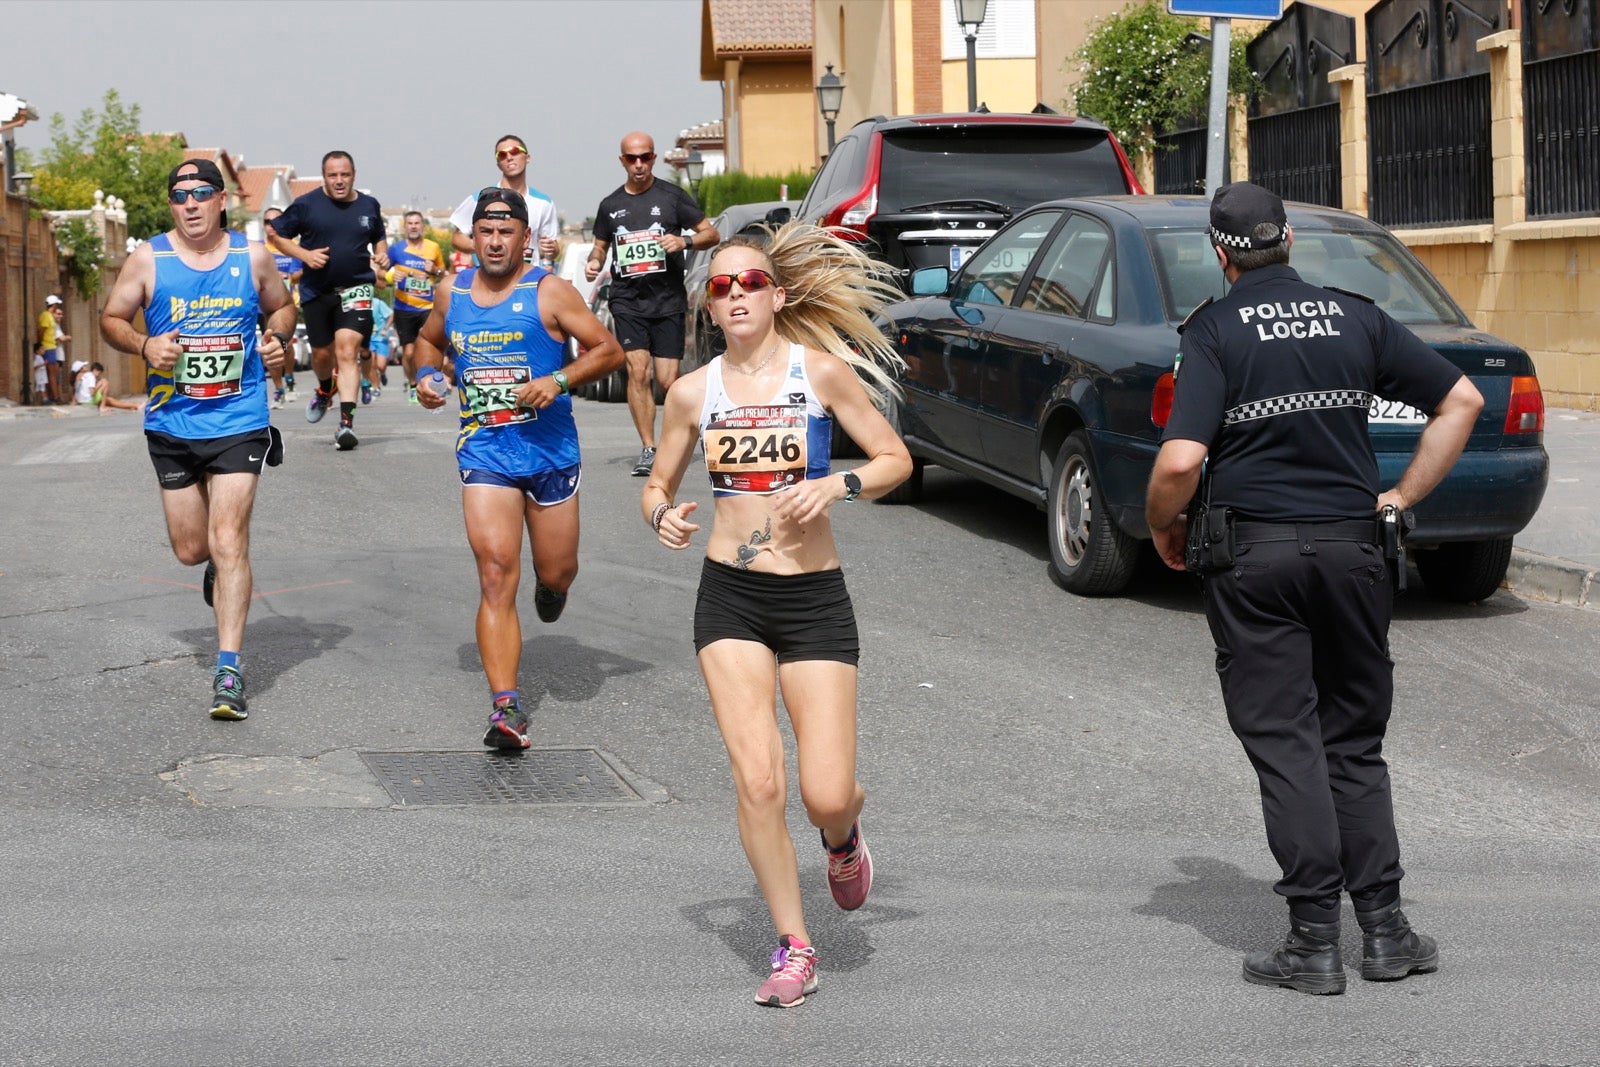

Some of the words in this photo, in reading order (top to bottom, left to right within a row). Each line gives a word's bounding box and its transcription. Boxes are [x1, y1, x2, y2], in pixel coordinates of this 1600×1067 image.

[625, 243, 658, 260] 495
[190, 295, 243, 310] olimpo
[1238, 301, 1345, 324] POLICIA
[468, 331, 524, 345] olimpo
[1256, 319, 1341, 342] LOCAL
[468, 345, 502, 353] deportes
[186, 355, 234, 378] 537
[745, 408, 769, 418] PREMIO
[771, 408, 779, 418] DE
[718, 434, 801, 465] 2246
